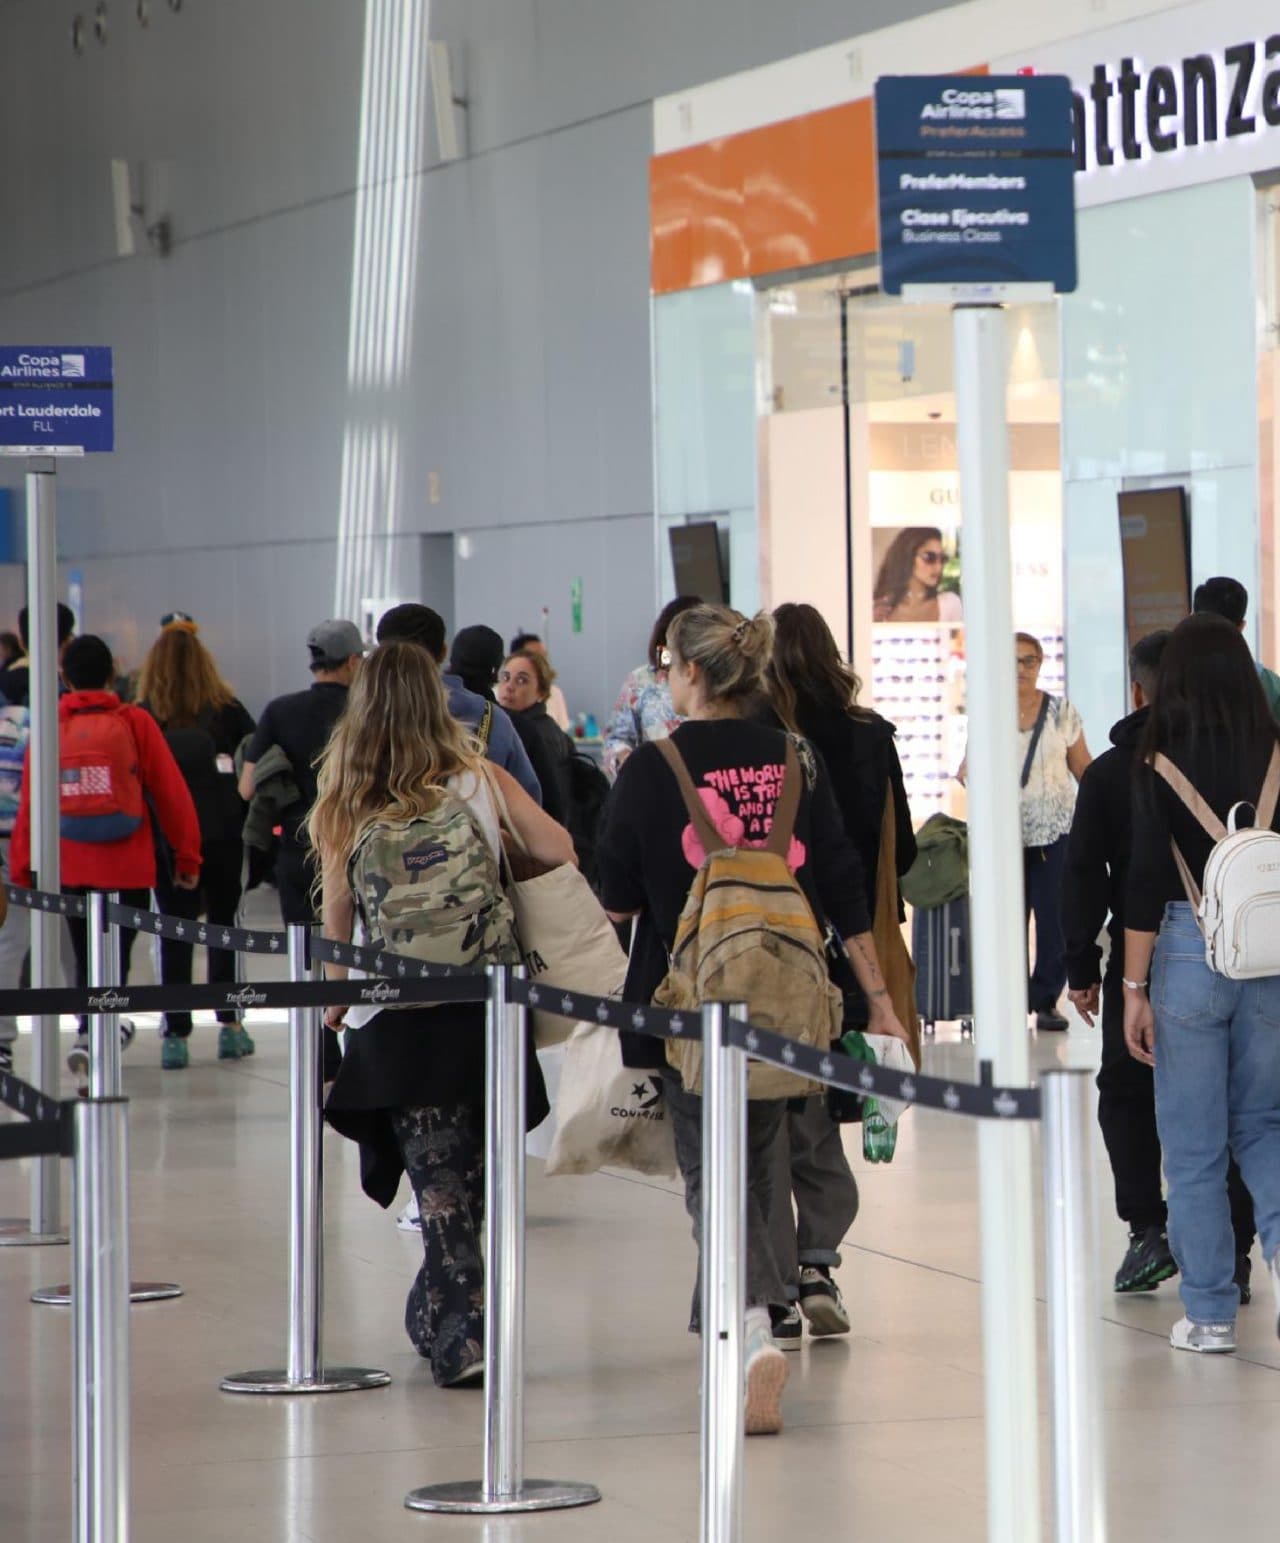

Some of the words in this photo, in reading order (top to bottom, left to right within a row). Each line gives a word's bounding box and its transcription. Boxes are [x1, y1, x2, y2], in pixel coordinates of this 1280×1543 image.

[942, 89, 994, 105] Copa
[921, 104, 995, 119] Airlines
[901, 209, 949, 225] Clase
[952, 209, 1029, 228] Ejecutiva
[903, 229, 960, 242] Business
[963, 229, 1002, 242] Class
[18, 354, 60, 367] Copa
[1, 366, 60, 377] Airlines
[0, 404, 15, 417] rt
[18, 403, 101, 417] Lauderdale
[33, 421, 54, 432] FLL
[704, 768, 739, 791] THE
[734, 784, 751, 801] IS
[739, 803, 763, 817] AND
[750, 818, 761, 832] A
